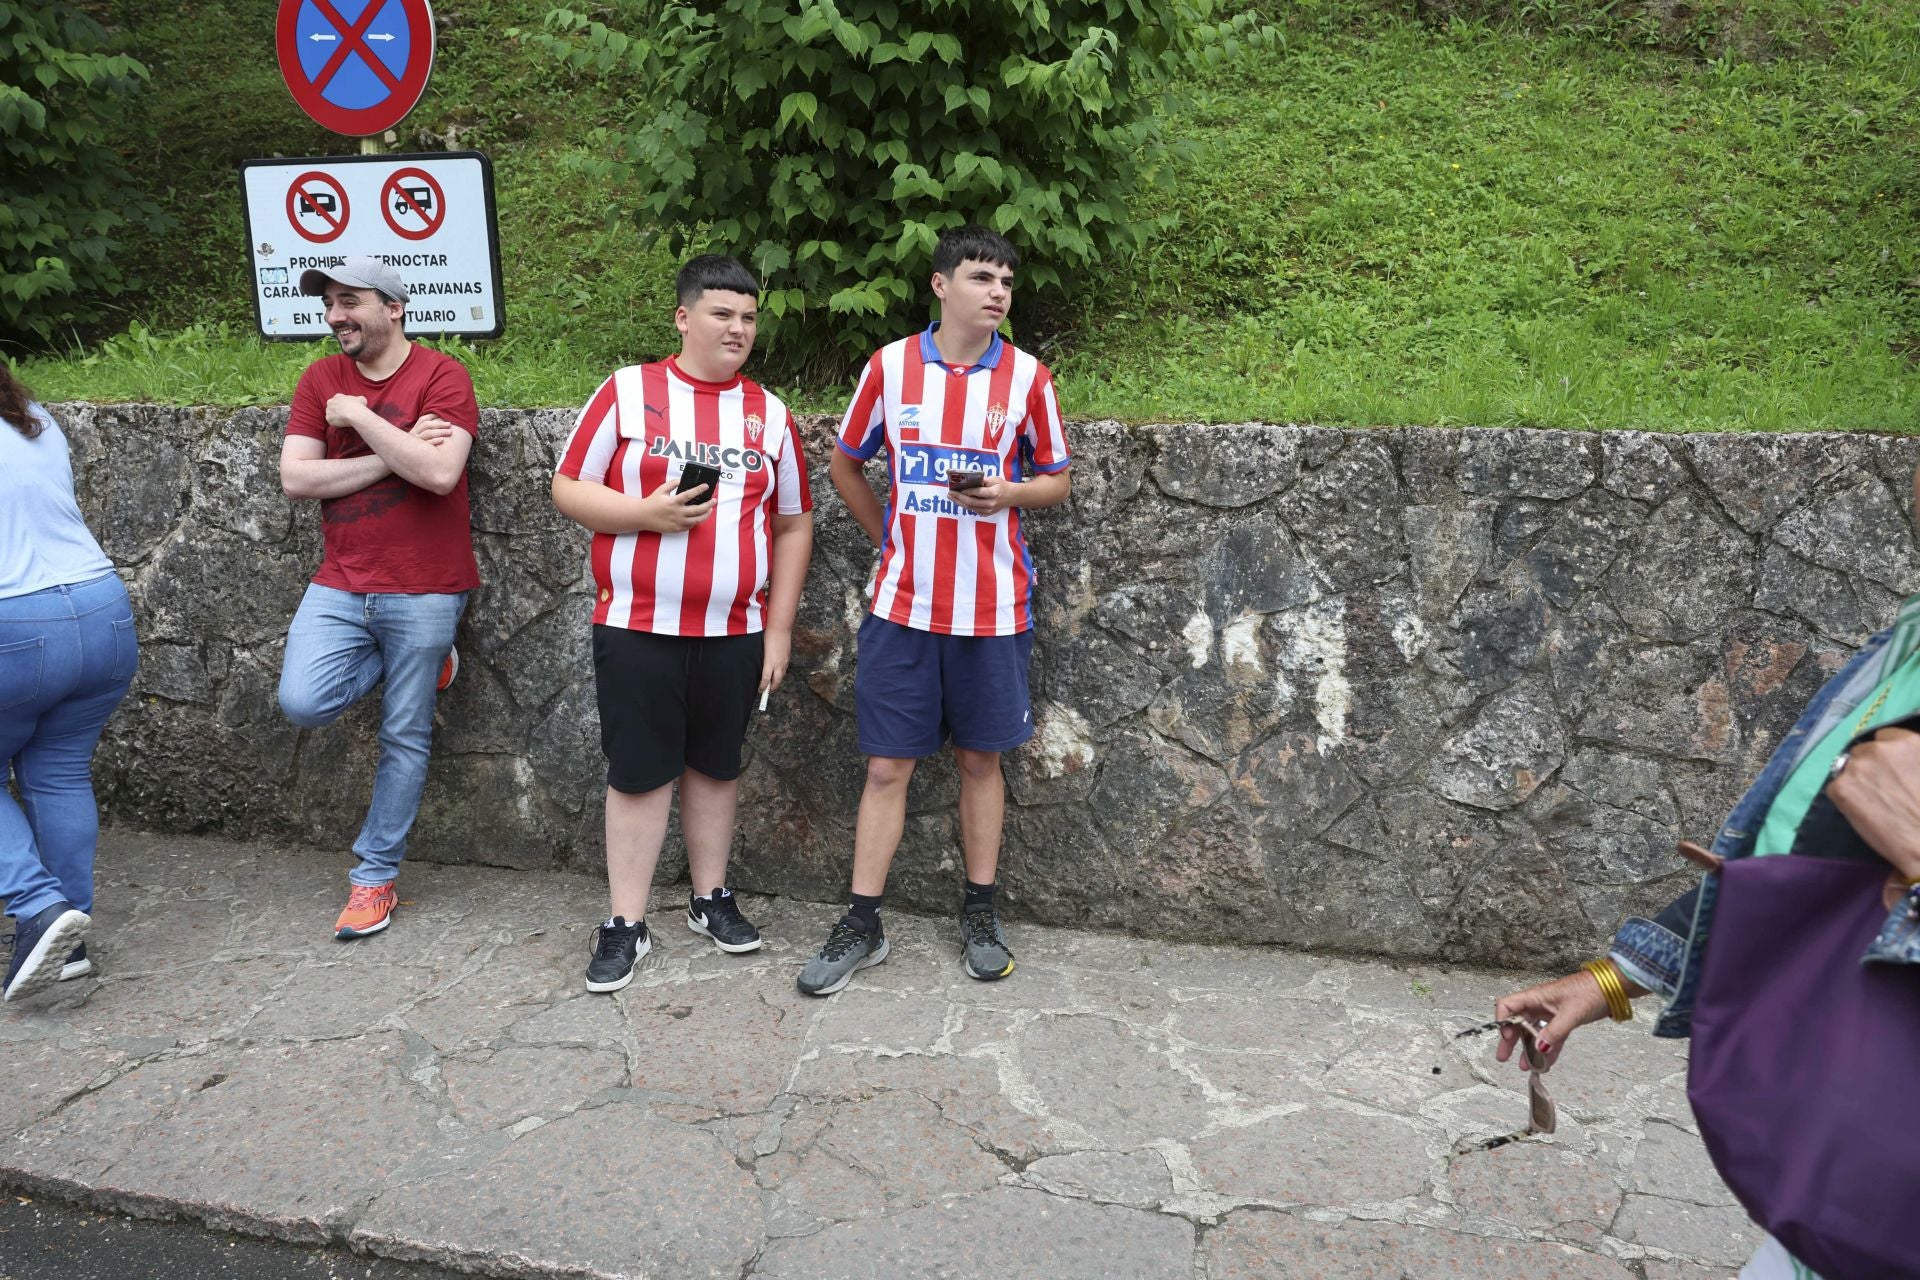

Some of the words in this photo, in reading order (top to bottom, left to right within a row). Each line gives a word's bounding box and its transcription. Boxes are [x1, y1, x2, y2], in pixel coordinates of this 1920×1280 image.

[367, 254, 448, 267] RNOCTAR
[293, 312, 312, 325] EN
[406, 310, 456, 323] TUARIO
[650, 437, 763, 472] JALISCO
